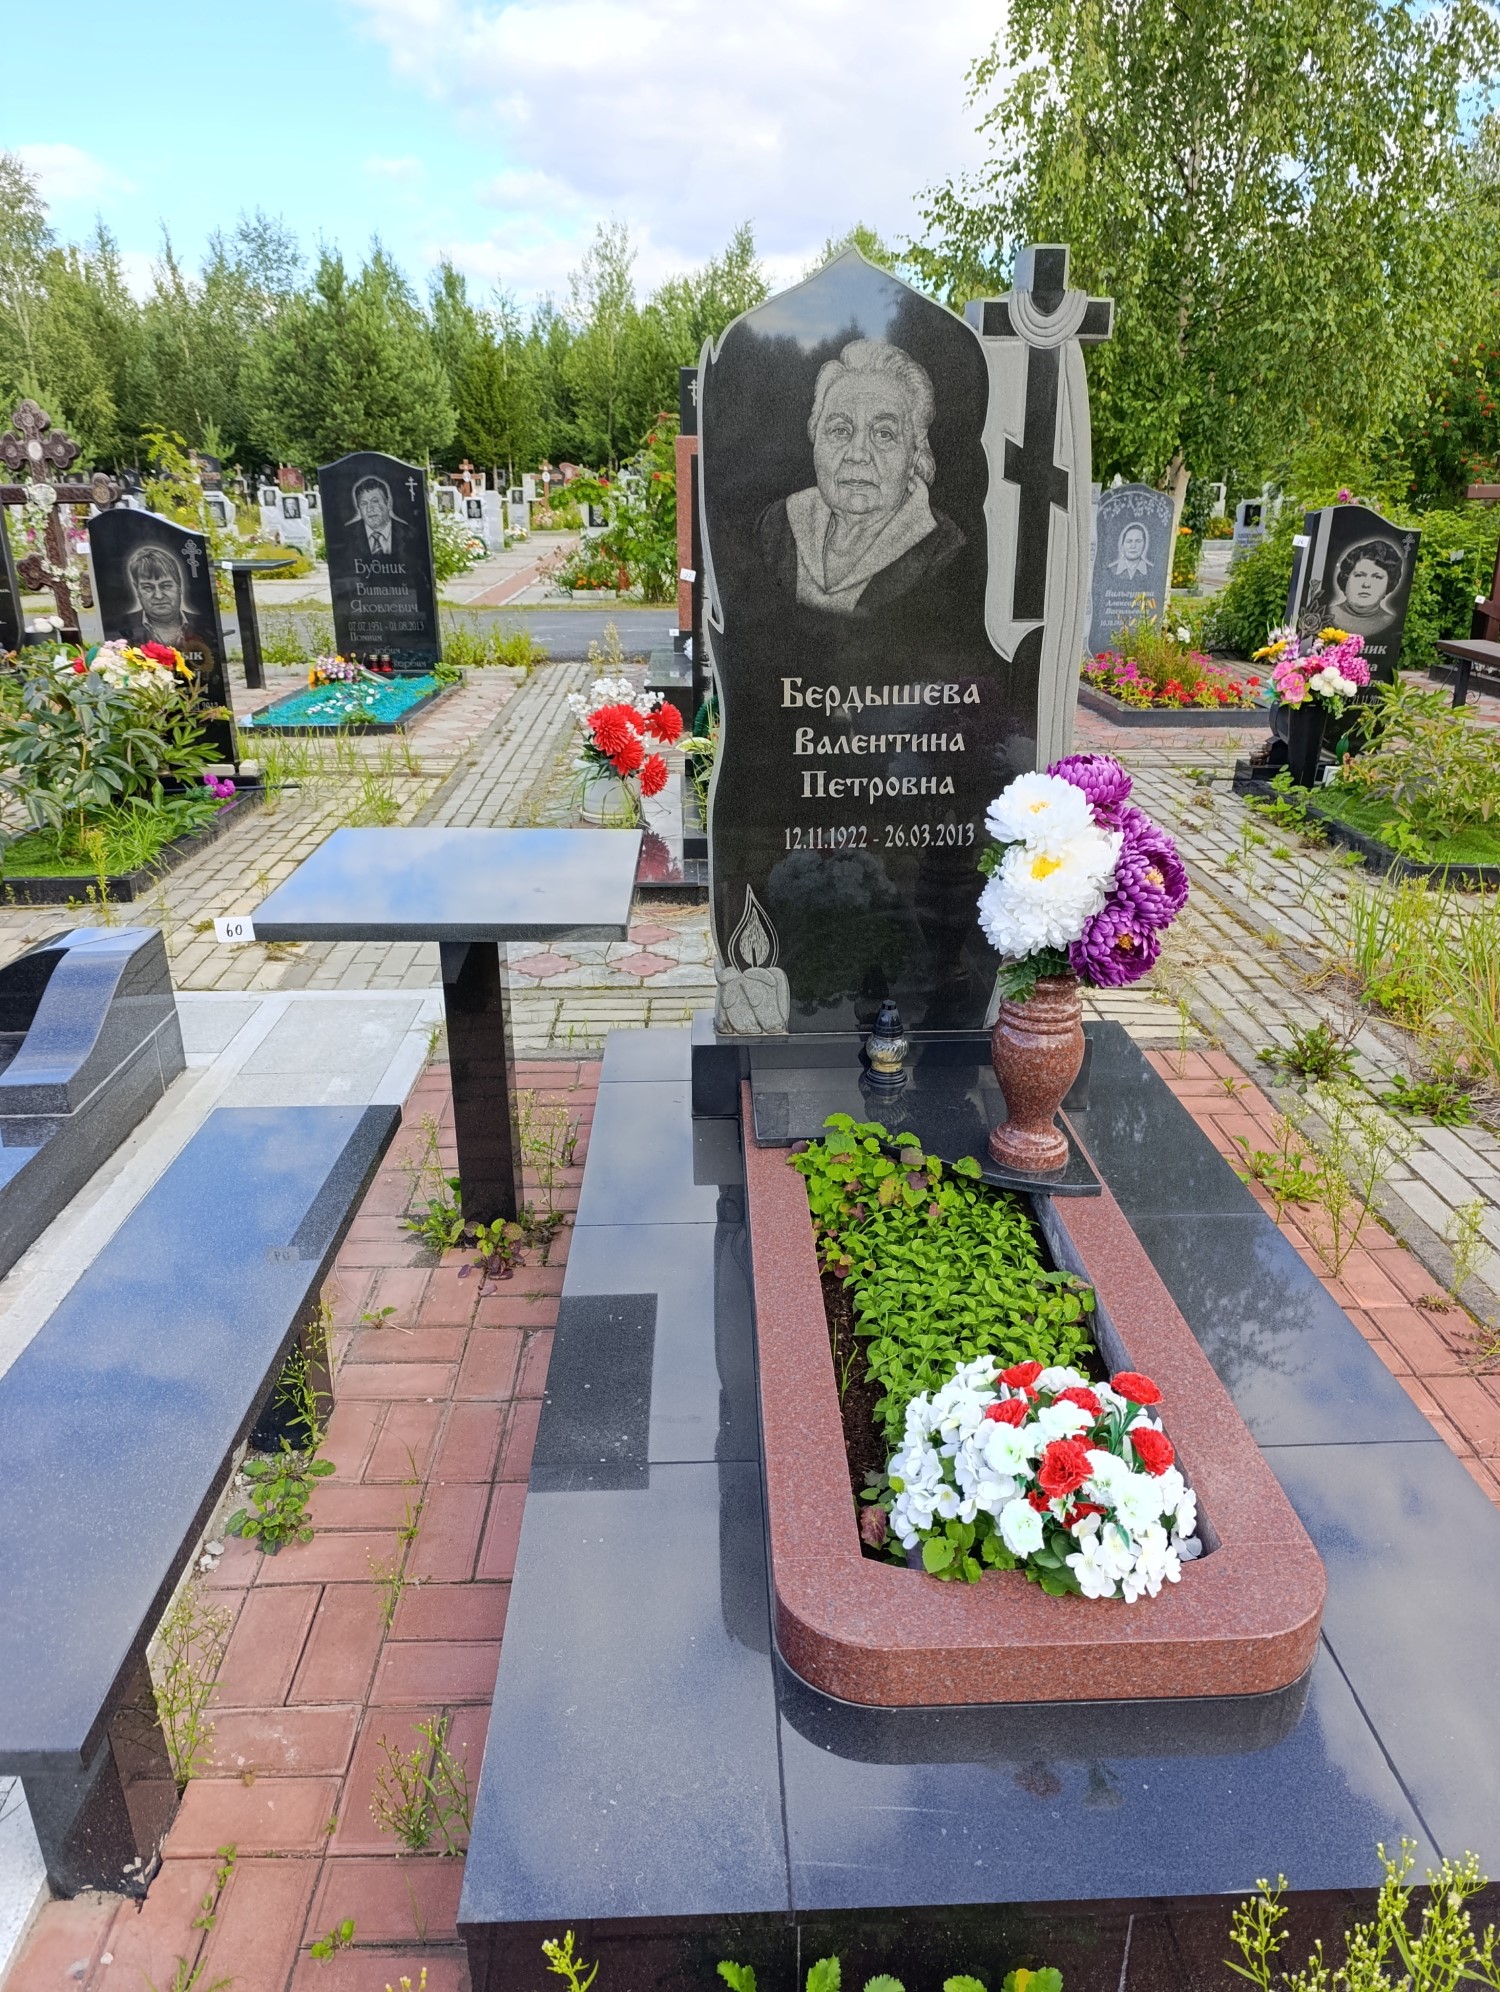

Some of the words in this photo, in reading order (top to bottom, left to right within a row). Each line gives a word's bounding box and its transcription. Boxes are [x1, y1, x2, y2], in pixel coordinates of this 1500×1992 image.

[354, 559, 406, 579] Будник
[356, 582, 409, 596] Виталий
[350, 600, 418, 613] Яковлевич
[393, 658, 426, 669] корбим
[780, 677, 981, 716] Бердышева
[793, 727, 966, 755] Валентина
[801, 771, 955, 804] Петровна
[784, 825, 868, 850] 12.11.1922
[885, 823, 975, 848] 26.03.2013
[226, 922, 243, 938] 60
